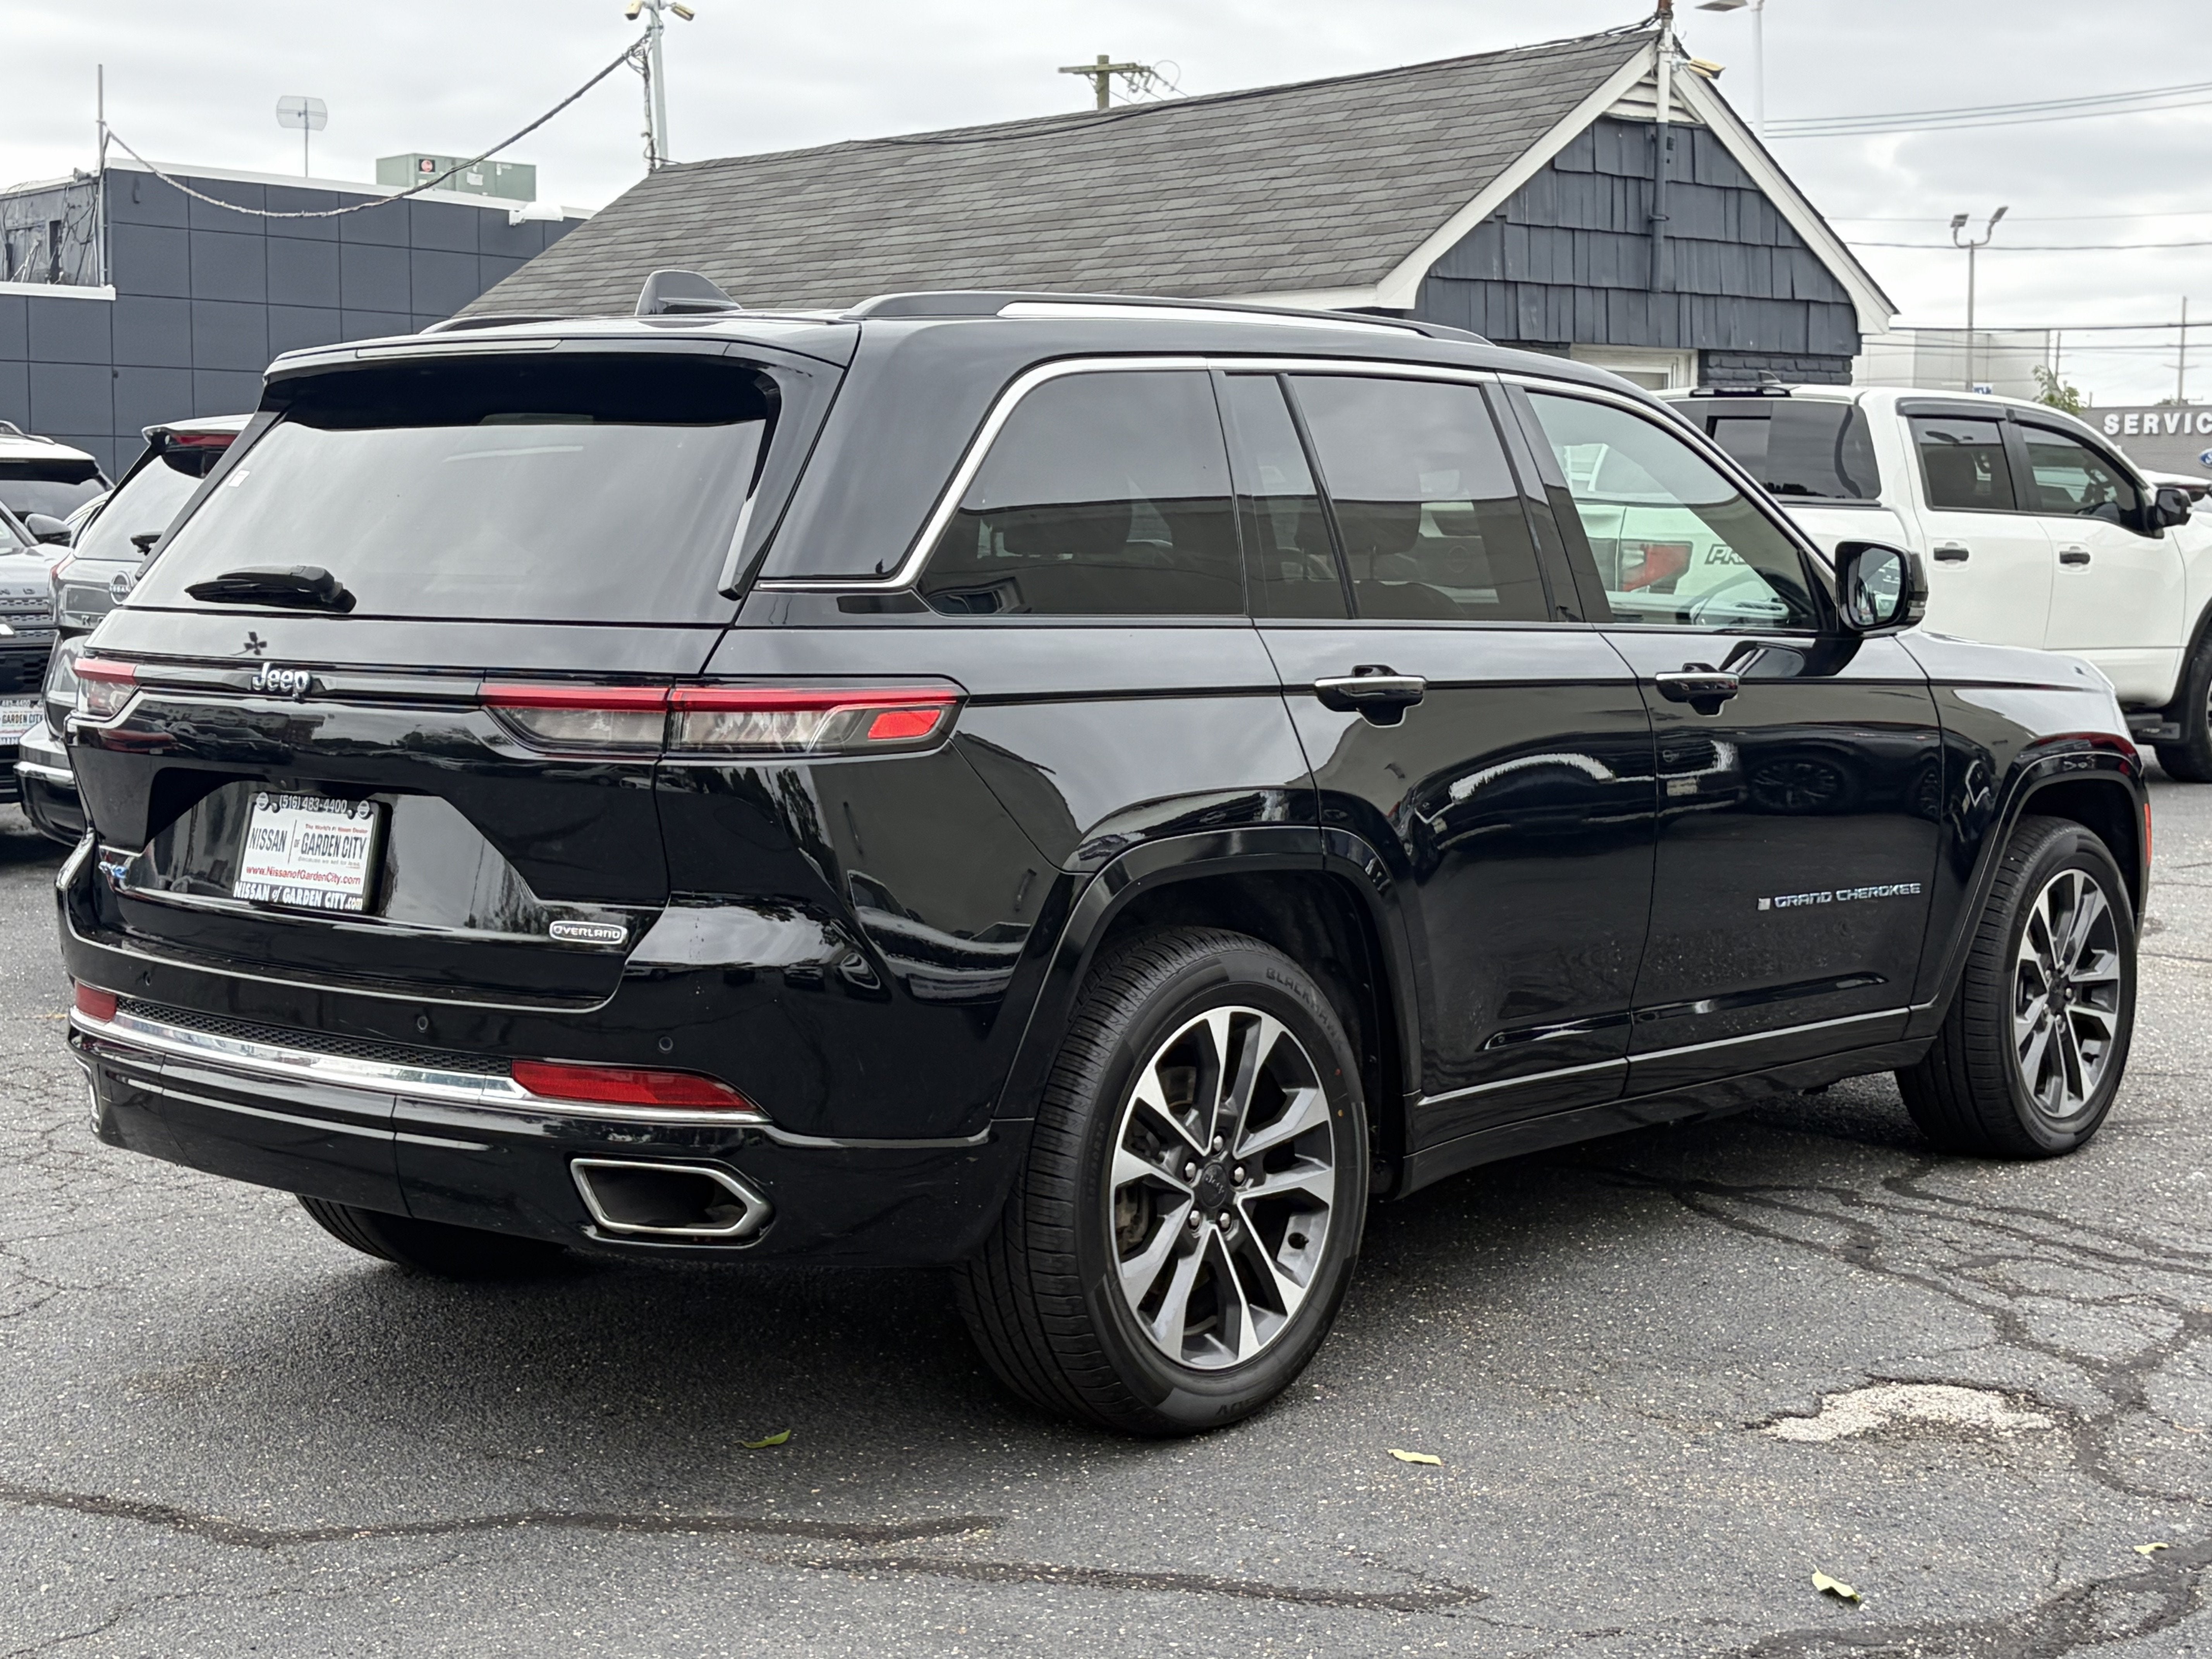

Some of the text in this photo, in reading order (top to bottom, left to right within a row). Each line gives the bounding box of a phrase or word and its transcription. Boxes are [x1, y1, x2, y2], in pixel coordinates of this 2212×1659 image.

[1705, 544, 1747, 565] PR
[252, 662, 309, 697] Jeep
[2, 714, 27, 723] GARDEN
[279, 795, 347, 813] (516) 483-4400
[249, 828, 288, 852] NISSAN
[301, 833, 342, 857] GARDEN
[342, 836, 367, 859] CITY
[246, 866, 361, 885] www.NissanofGardenCity.com
[233, 881, 270, 901] NISSAN
[282, 888, 322, 907] GARDEN
[1775, 883, 1921, 907] GRAND CHEROKEE
[553, 926, 620, 939] OVERLAND
